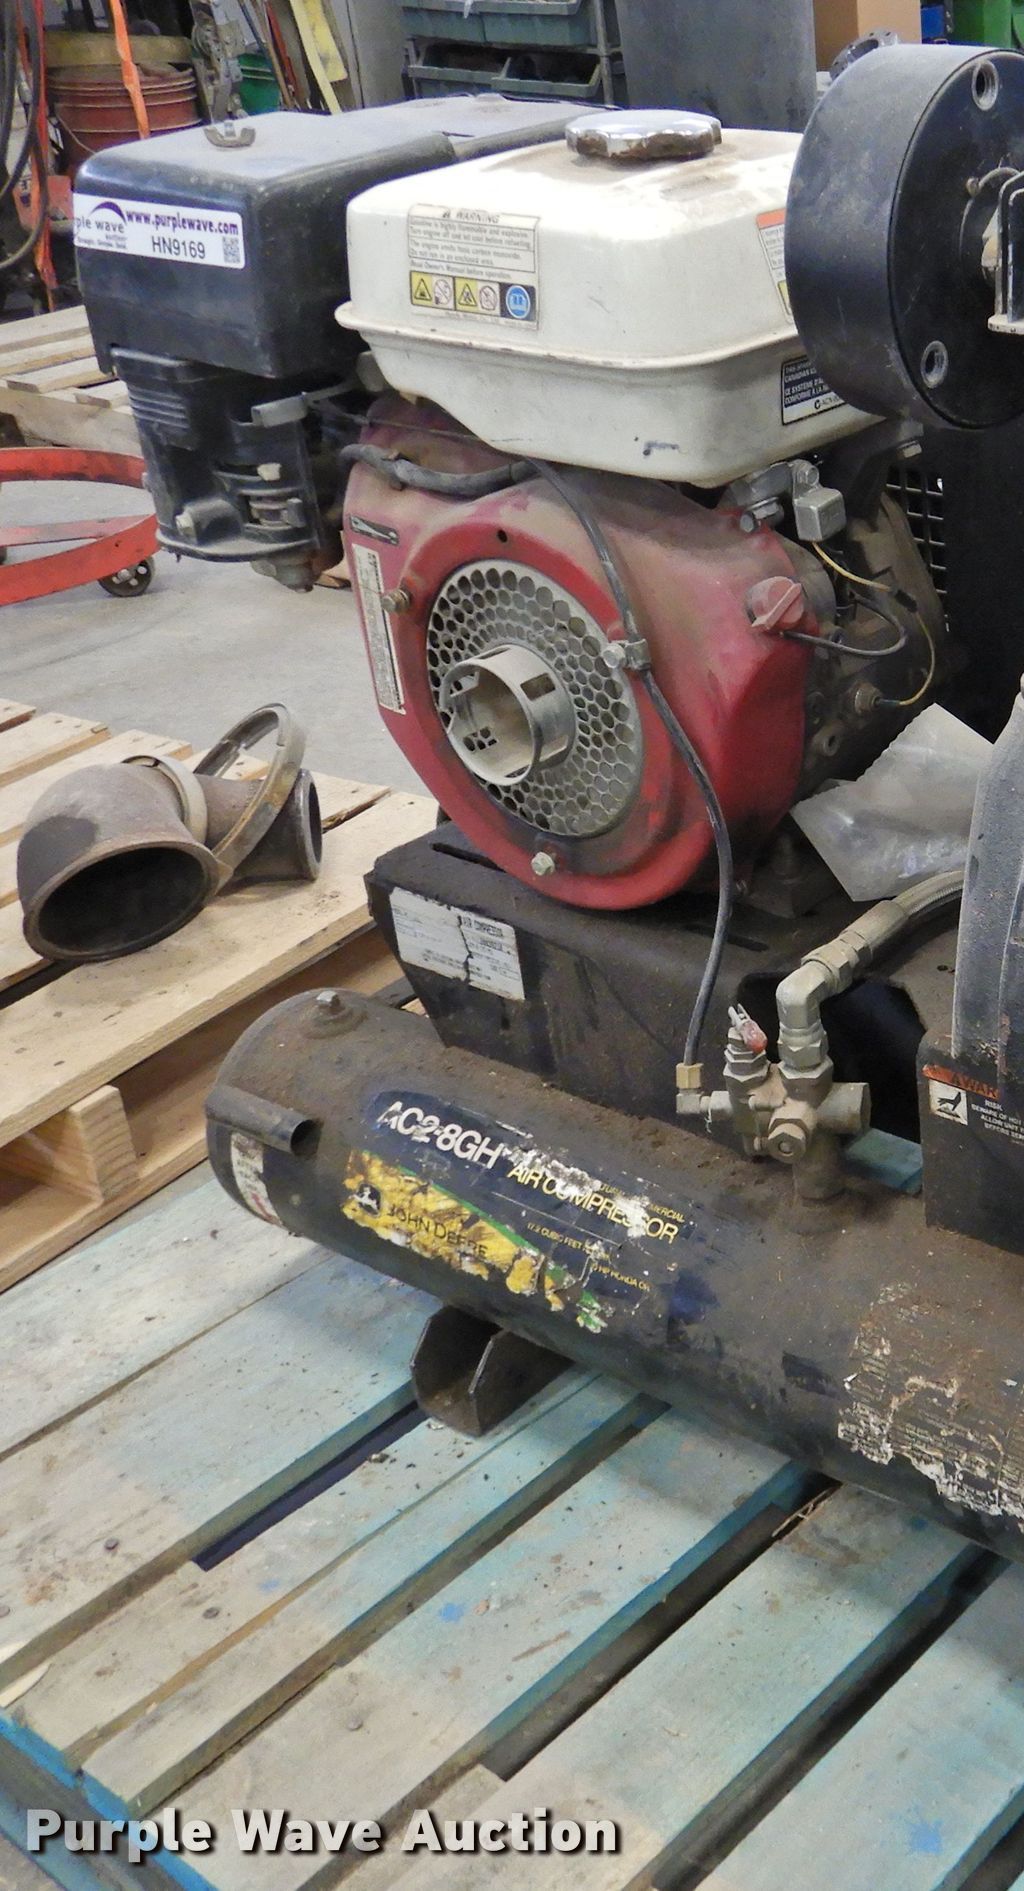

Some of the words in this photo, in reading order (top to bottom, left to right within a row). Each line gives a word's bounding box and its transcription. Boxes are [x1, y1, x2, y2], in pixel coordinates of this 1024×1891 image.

[95, 219, 125, 234] wave
[126, 210, 239, 236] www.purplewave.com
[151, 235, 206, 260] HN9169
[387, 1203, 430, 1233] JOHN
[507, 1166, 543, 1189] AIR
[542, 1176, 679, 1245] CMPREOR
